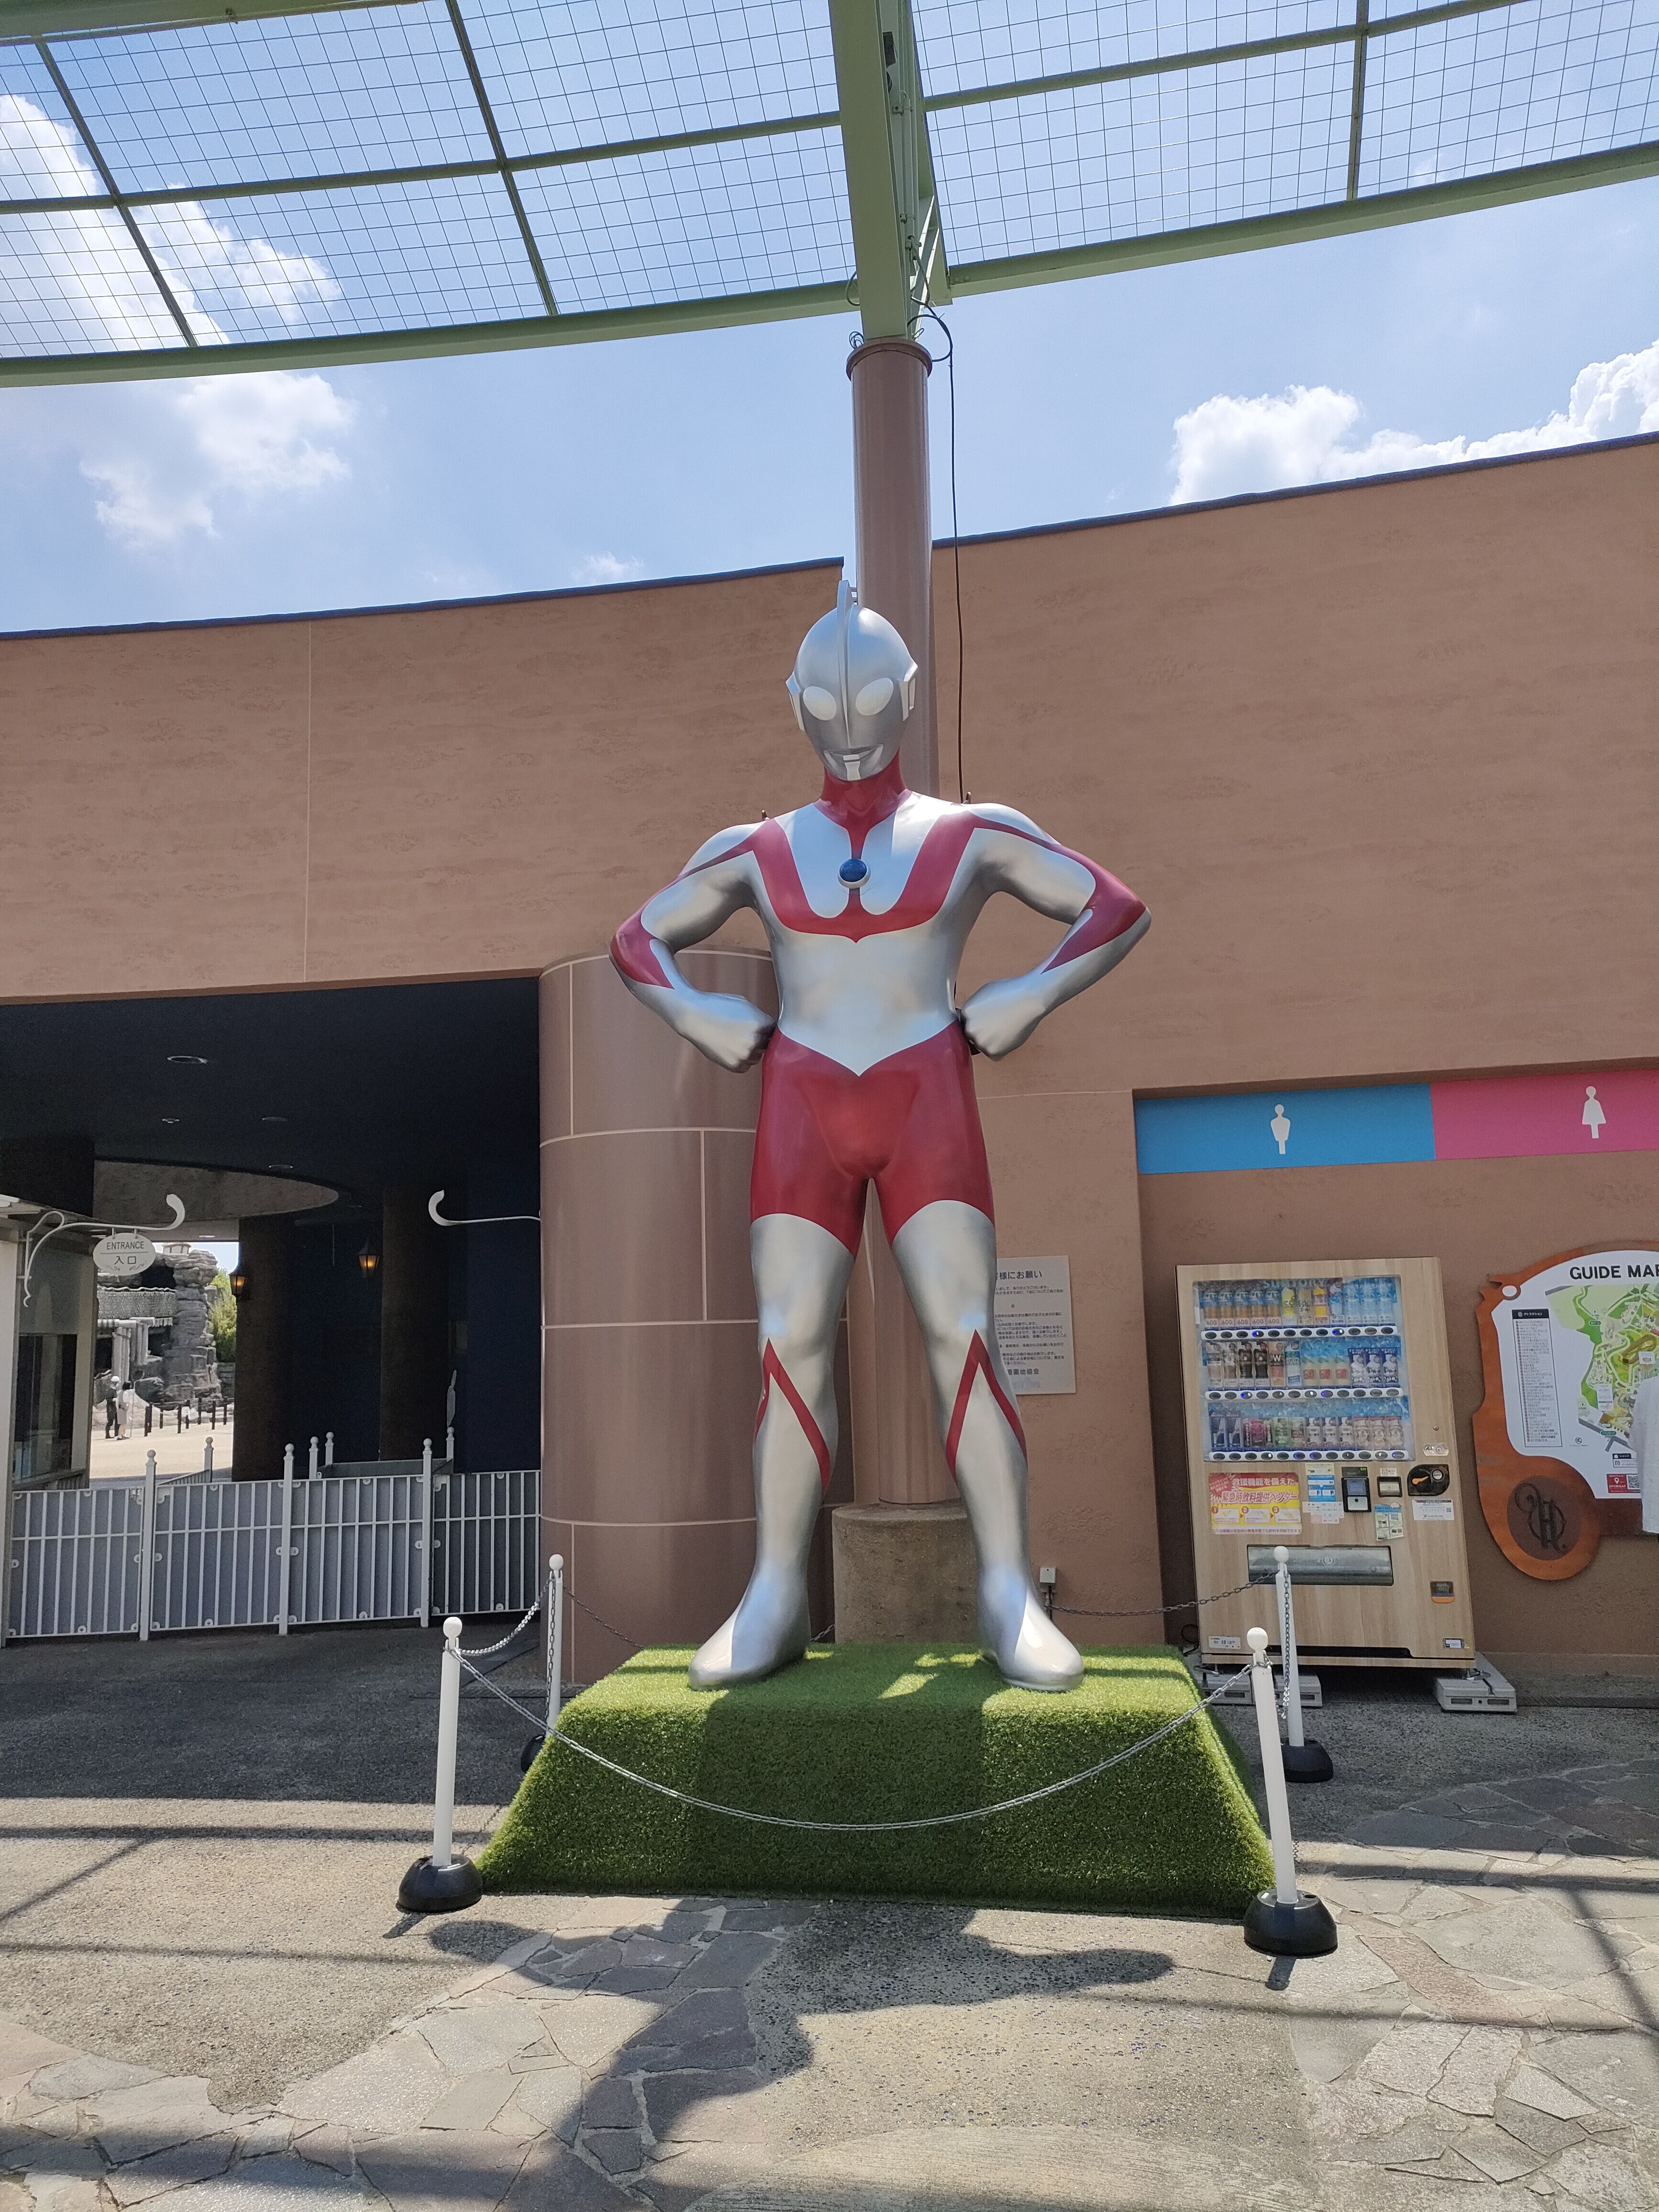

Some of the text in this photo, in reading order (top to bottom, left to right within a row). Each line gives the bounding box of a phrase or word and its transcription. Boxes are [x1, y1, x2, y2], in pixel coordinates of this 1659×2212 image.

[107, 1241, 144, 1250] ENTRANCE
[114, 1256, 136, 1265] 入口
[996, 1271, 1042, 1280] 様にお願い
[1570, 1265, 1621, 1280] GUIDE
[1232, 1478, 1295, 1486] 救援機能を備えた
[1221, 1491, 1298, 1504] 緊急時飲料提供ベンダー
